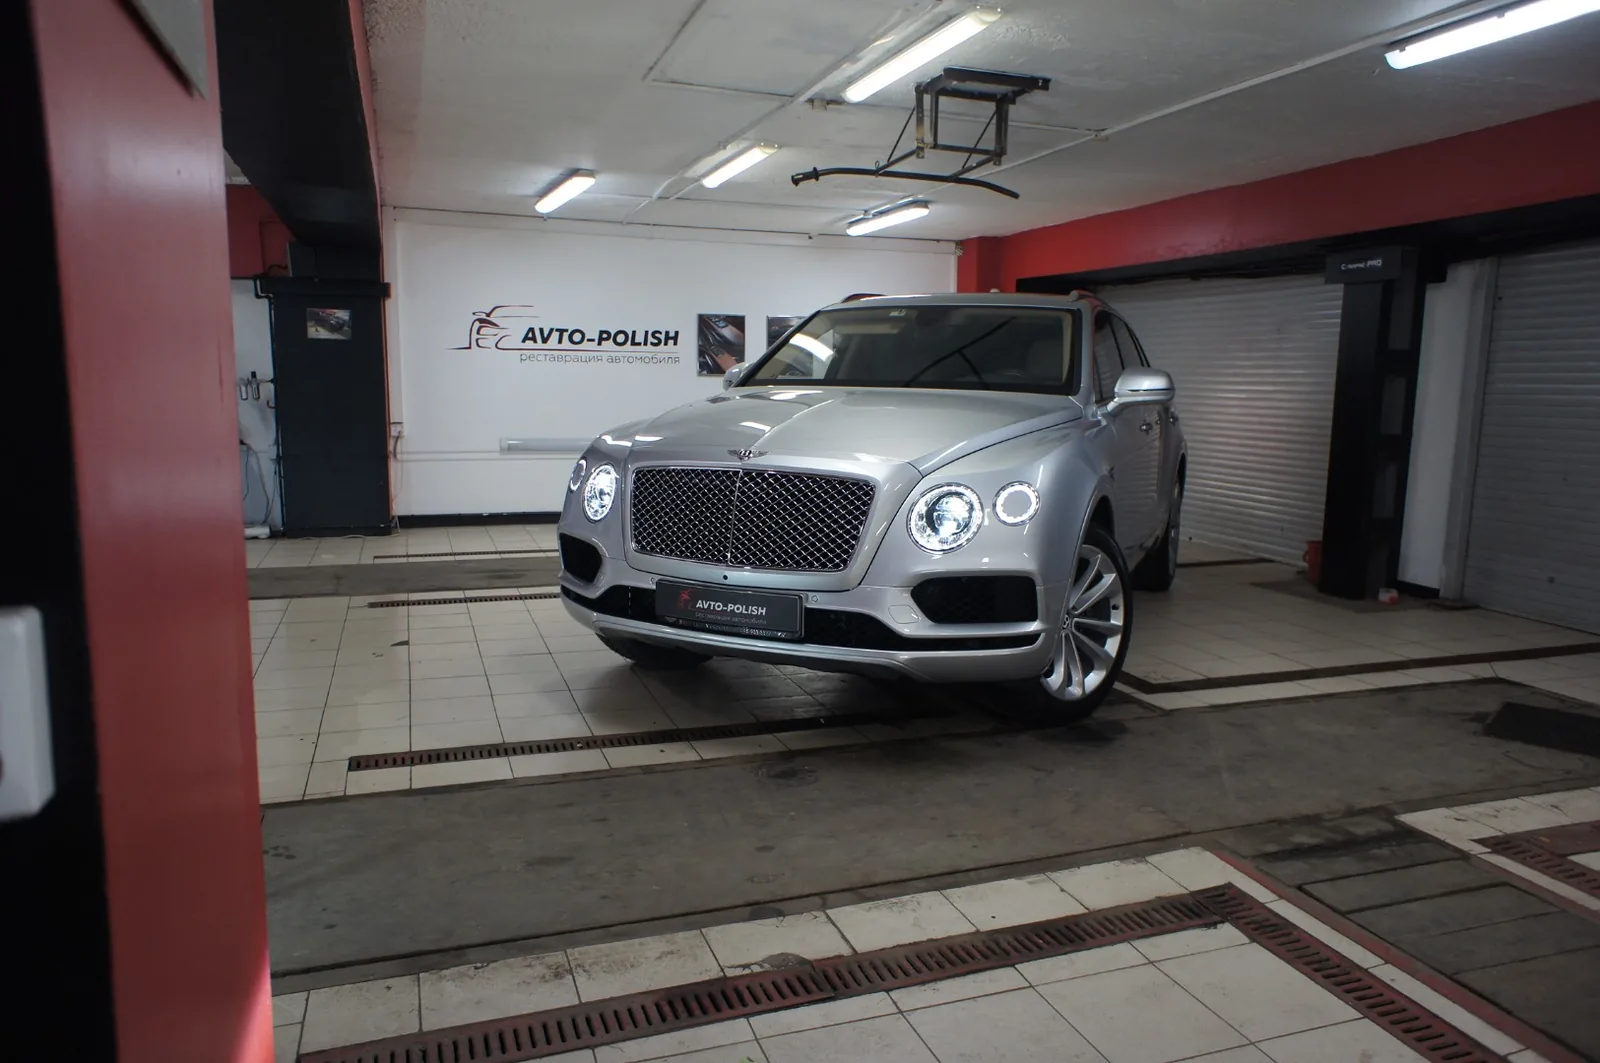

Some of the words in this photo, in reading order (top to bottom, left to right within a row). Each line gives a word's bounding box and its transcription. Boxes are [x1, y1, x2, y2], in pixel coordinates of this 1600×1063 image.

[521, 327, 679, 347] AVTO-POLISH
[520, 353, 603, 364] реставрация
[606, 354, 680, 365] автомобиля
[696, 600, 767, 616] AVTO-POLISH
